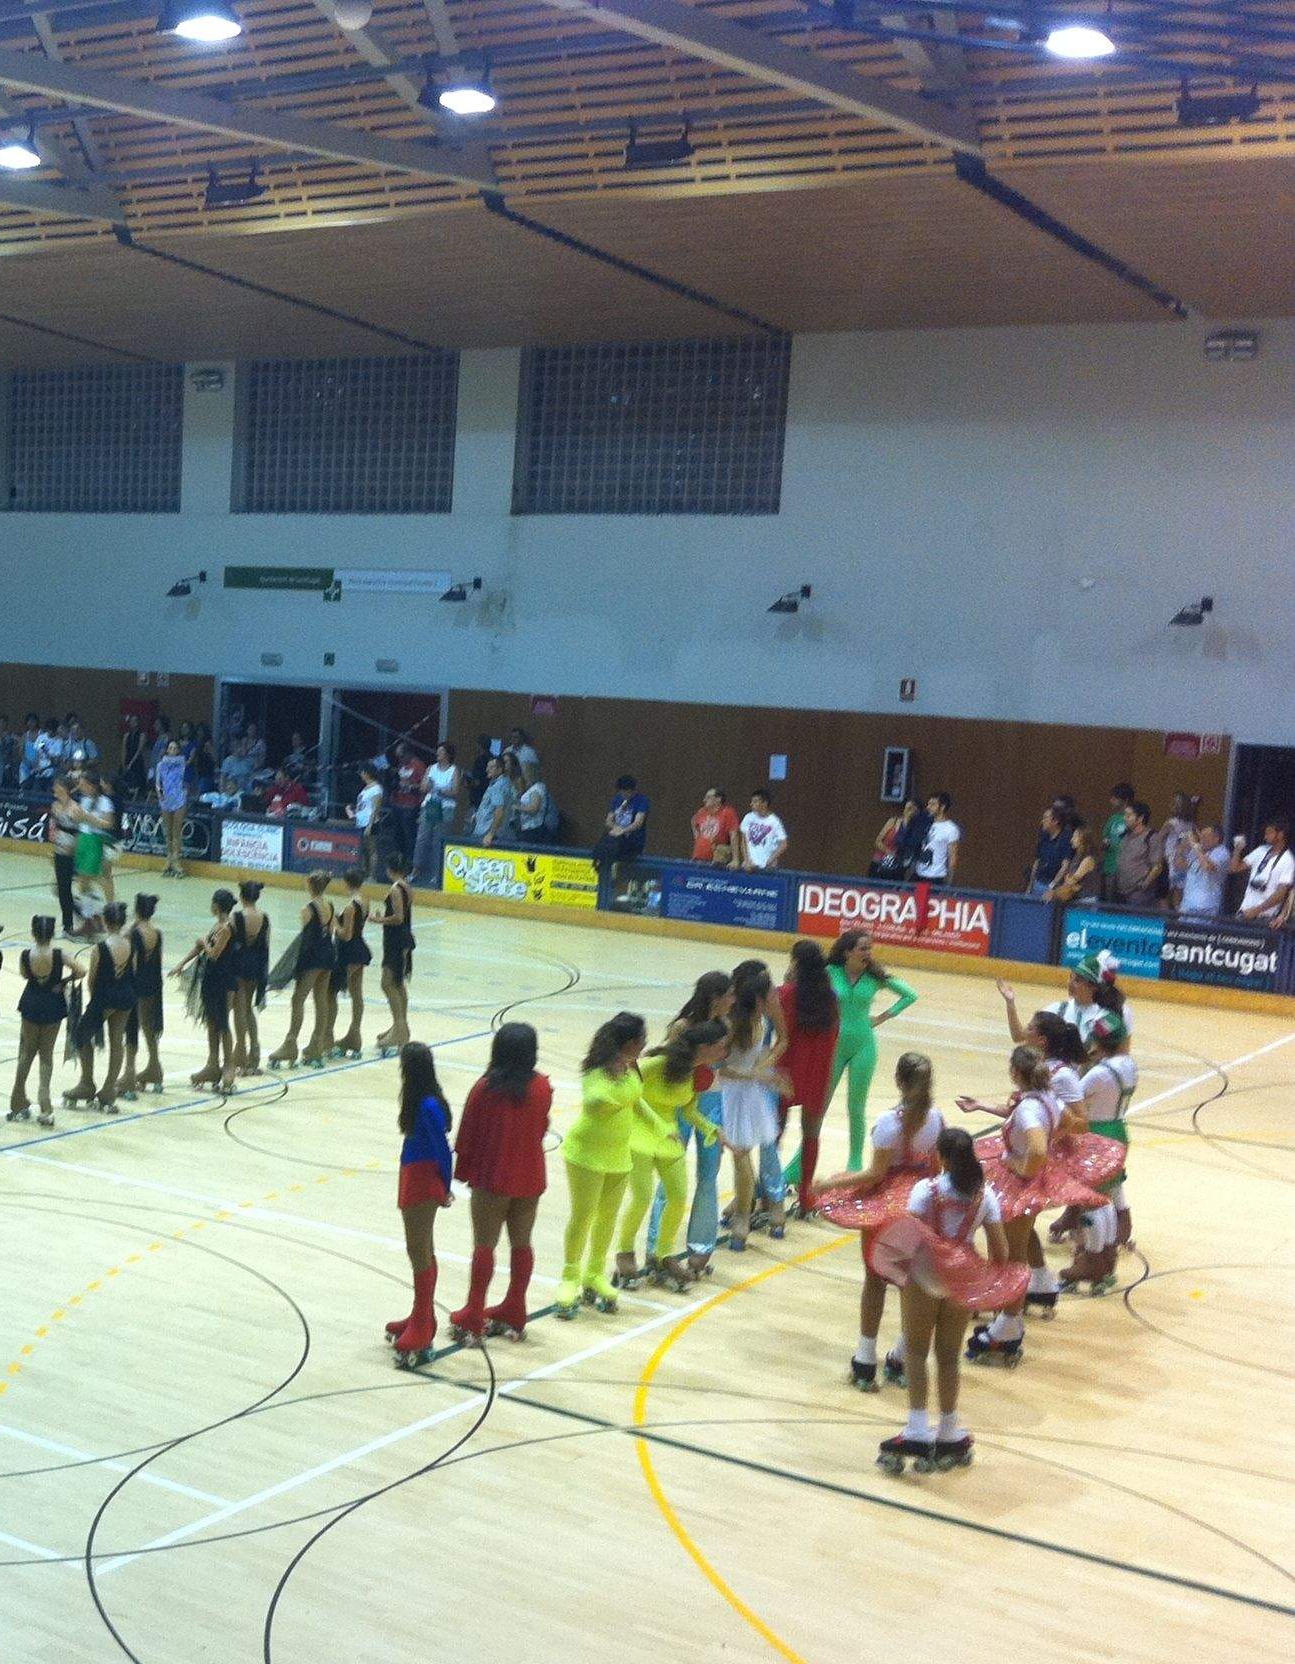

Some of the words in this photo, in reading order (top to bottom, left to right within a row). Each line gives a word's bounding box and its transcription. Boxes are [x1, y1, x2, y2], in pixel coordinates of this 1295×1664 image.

[446, 848, 514, 879] Queen
[465, 873, 529, 900] Skate
[1161, 942, 1278, 975] santcugat
